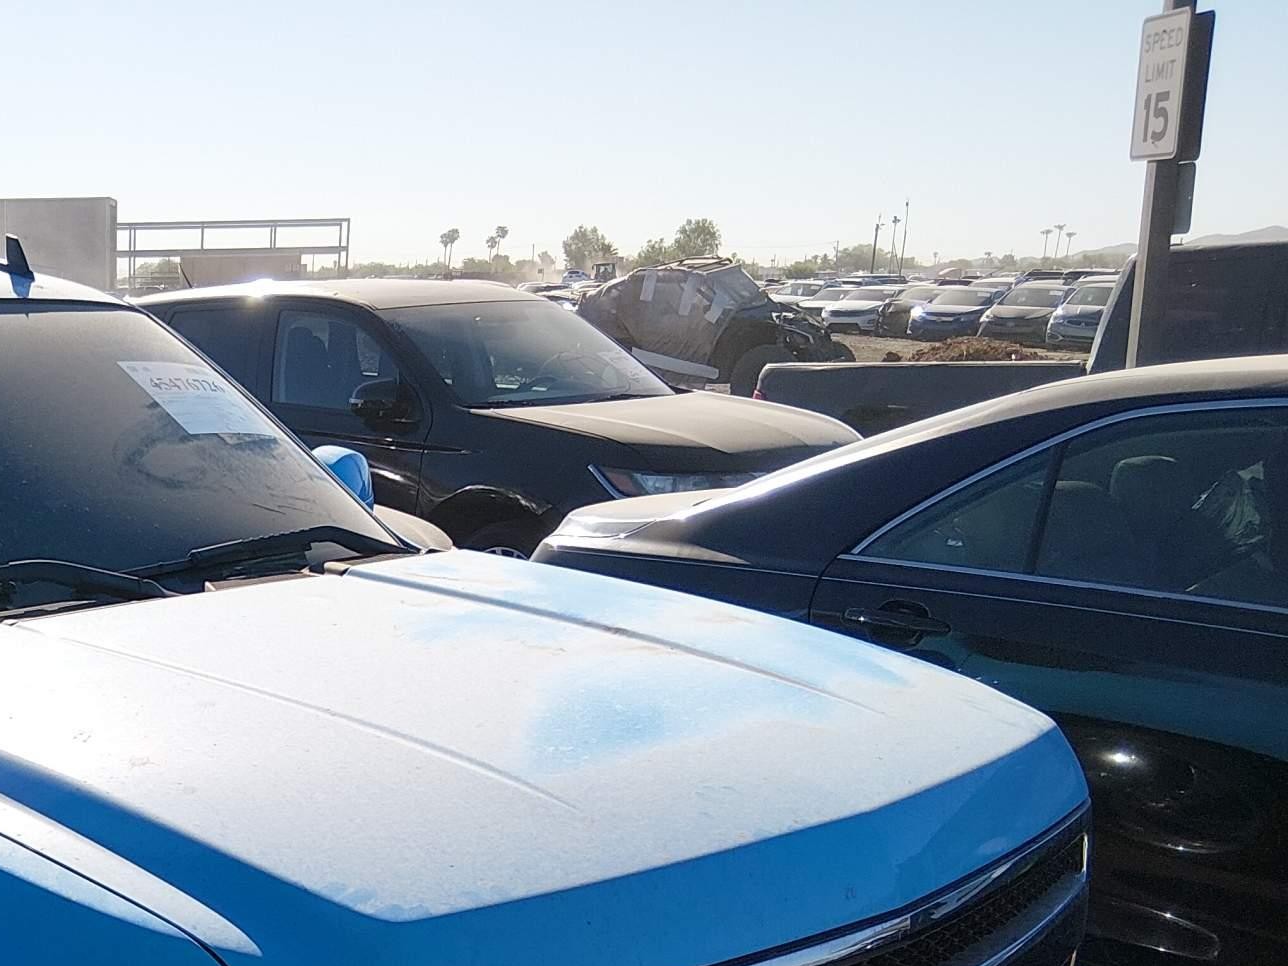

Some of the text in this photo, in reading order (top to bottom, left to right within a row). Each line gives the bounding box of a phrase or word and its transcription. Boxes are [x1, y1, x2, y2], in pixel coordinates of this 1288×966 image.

[1144, 27, 1183, 53] SPEED
[1144, 59, 1176, 83] LIMIT
[1142, 90, 1171, 143] 15
